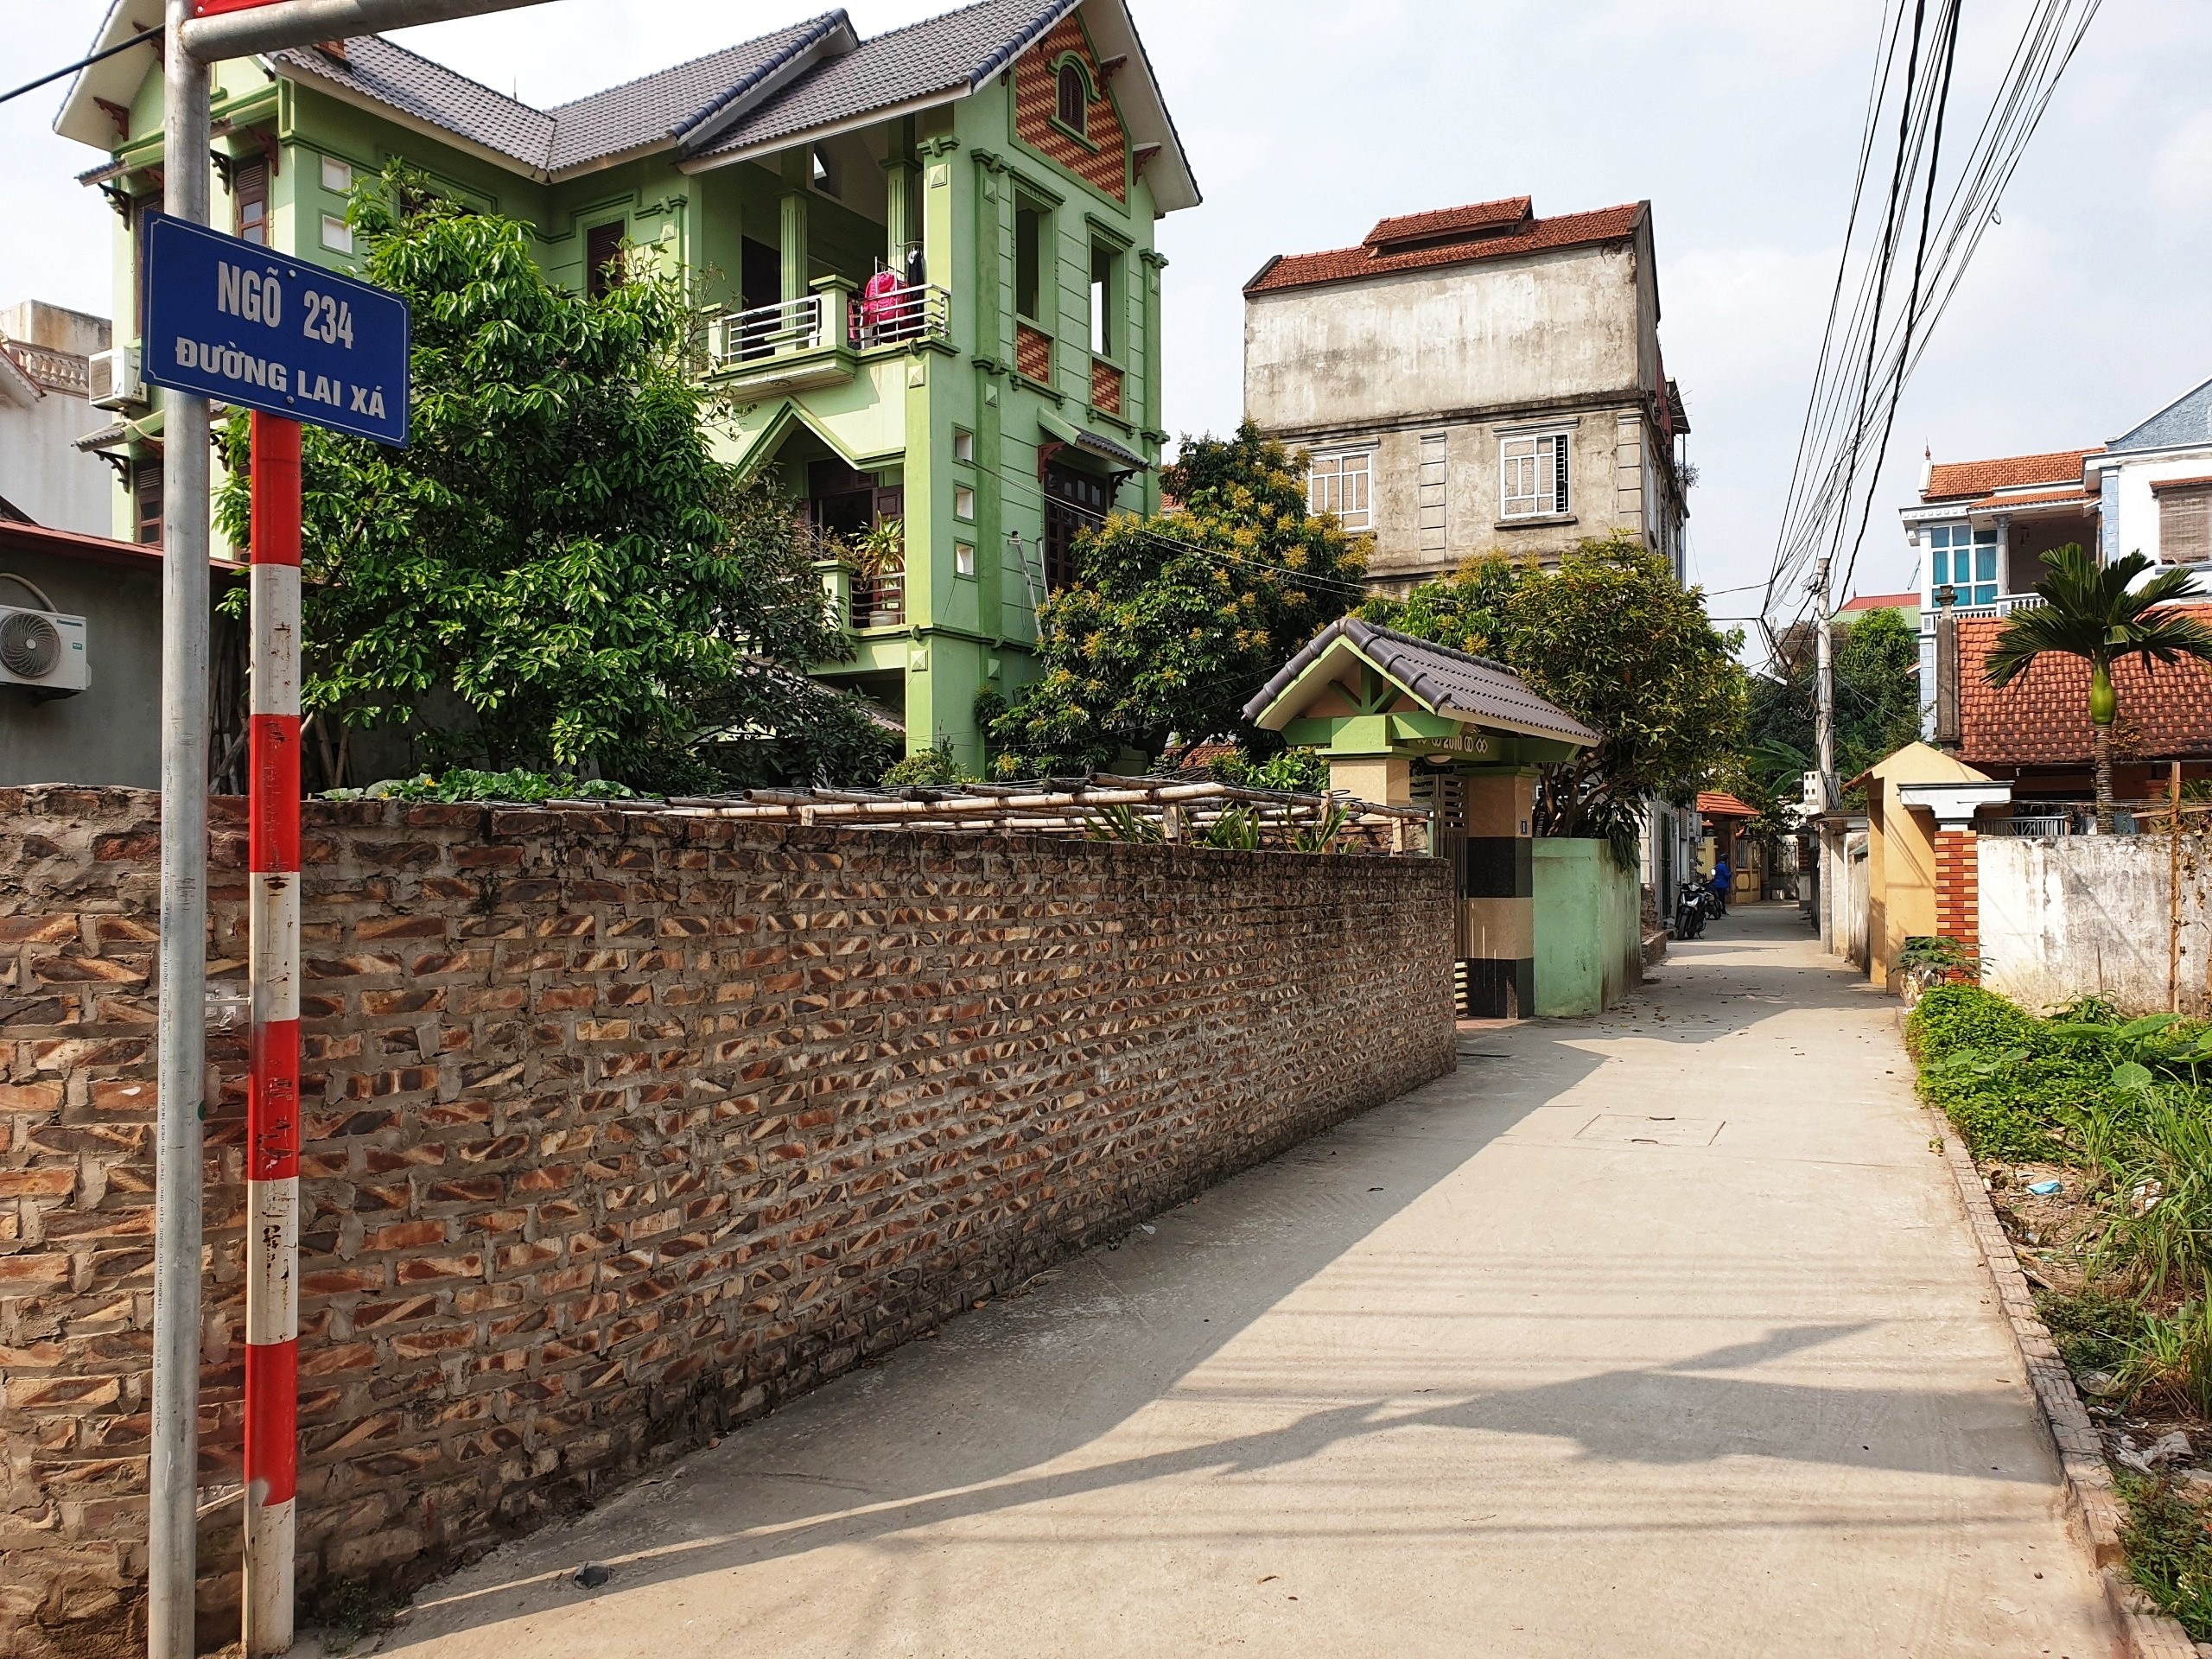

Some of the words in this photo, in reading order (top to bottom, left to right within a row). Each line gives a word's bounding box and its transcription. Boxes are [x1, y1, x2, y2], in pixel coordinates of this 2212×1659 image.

[218, 260, 282, 328] NGÕ
[303, 289, 353, 350] 234
[175, 336, 287, 391] ĐƯỜNG
[297, 370, 340, 407] LAI
[350, 385, 386, 420] XÁ
